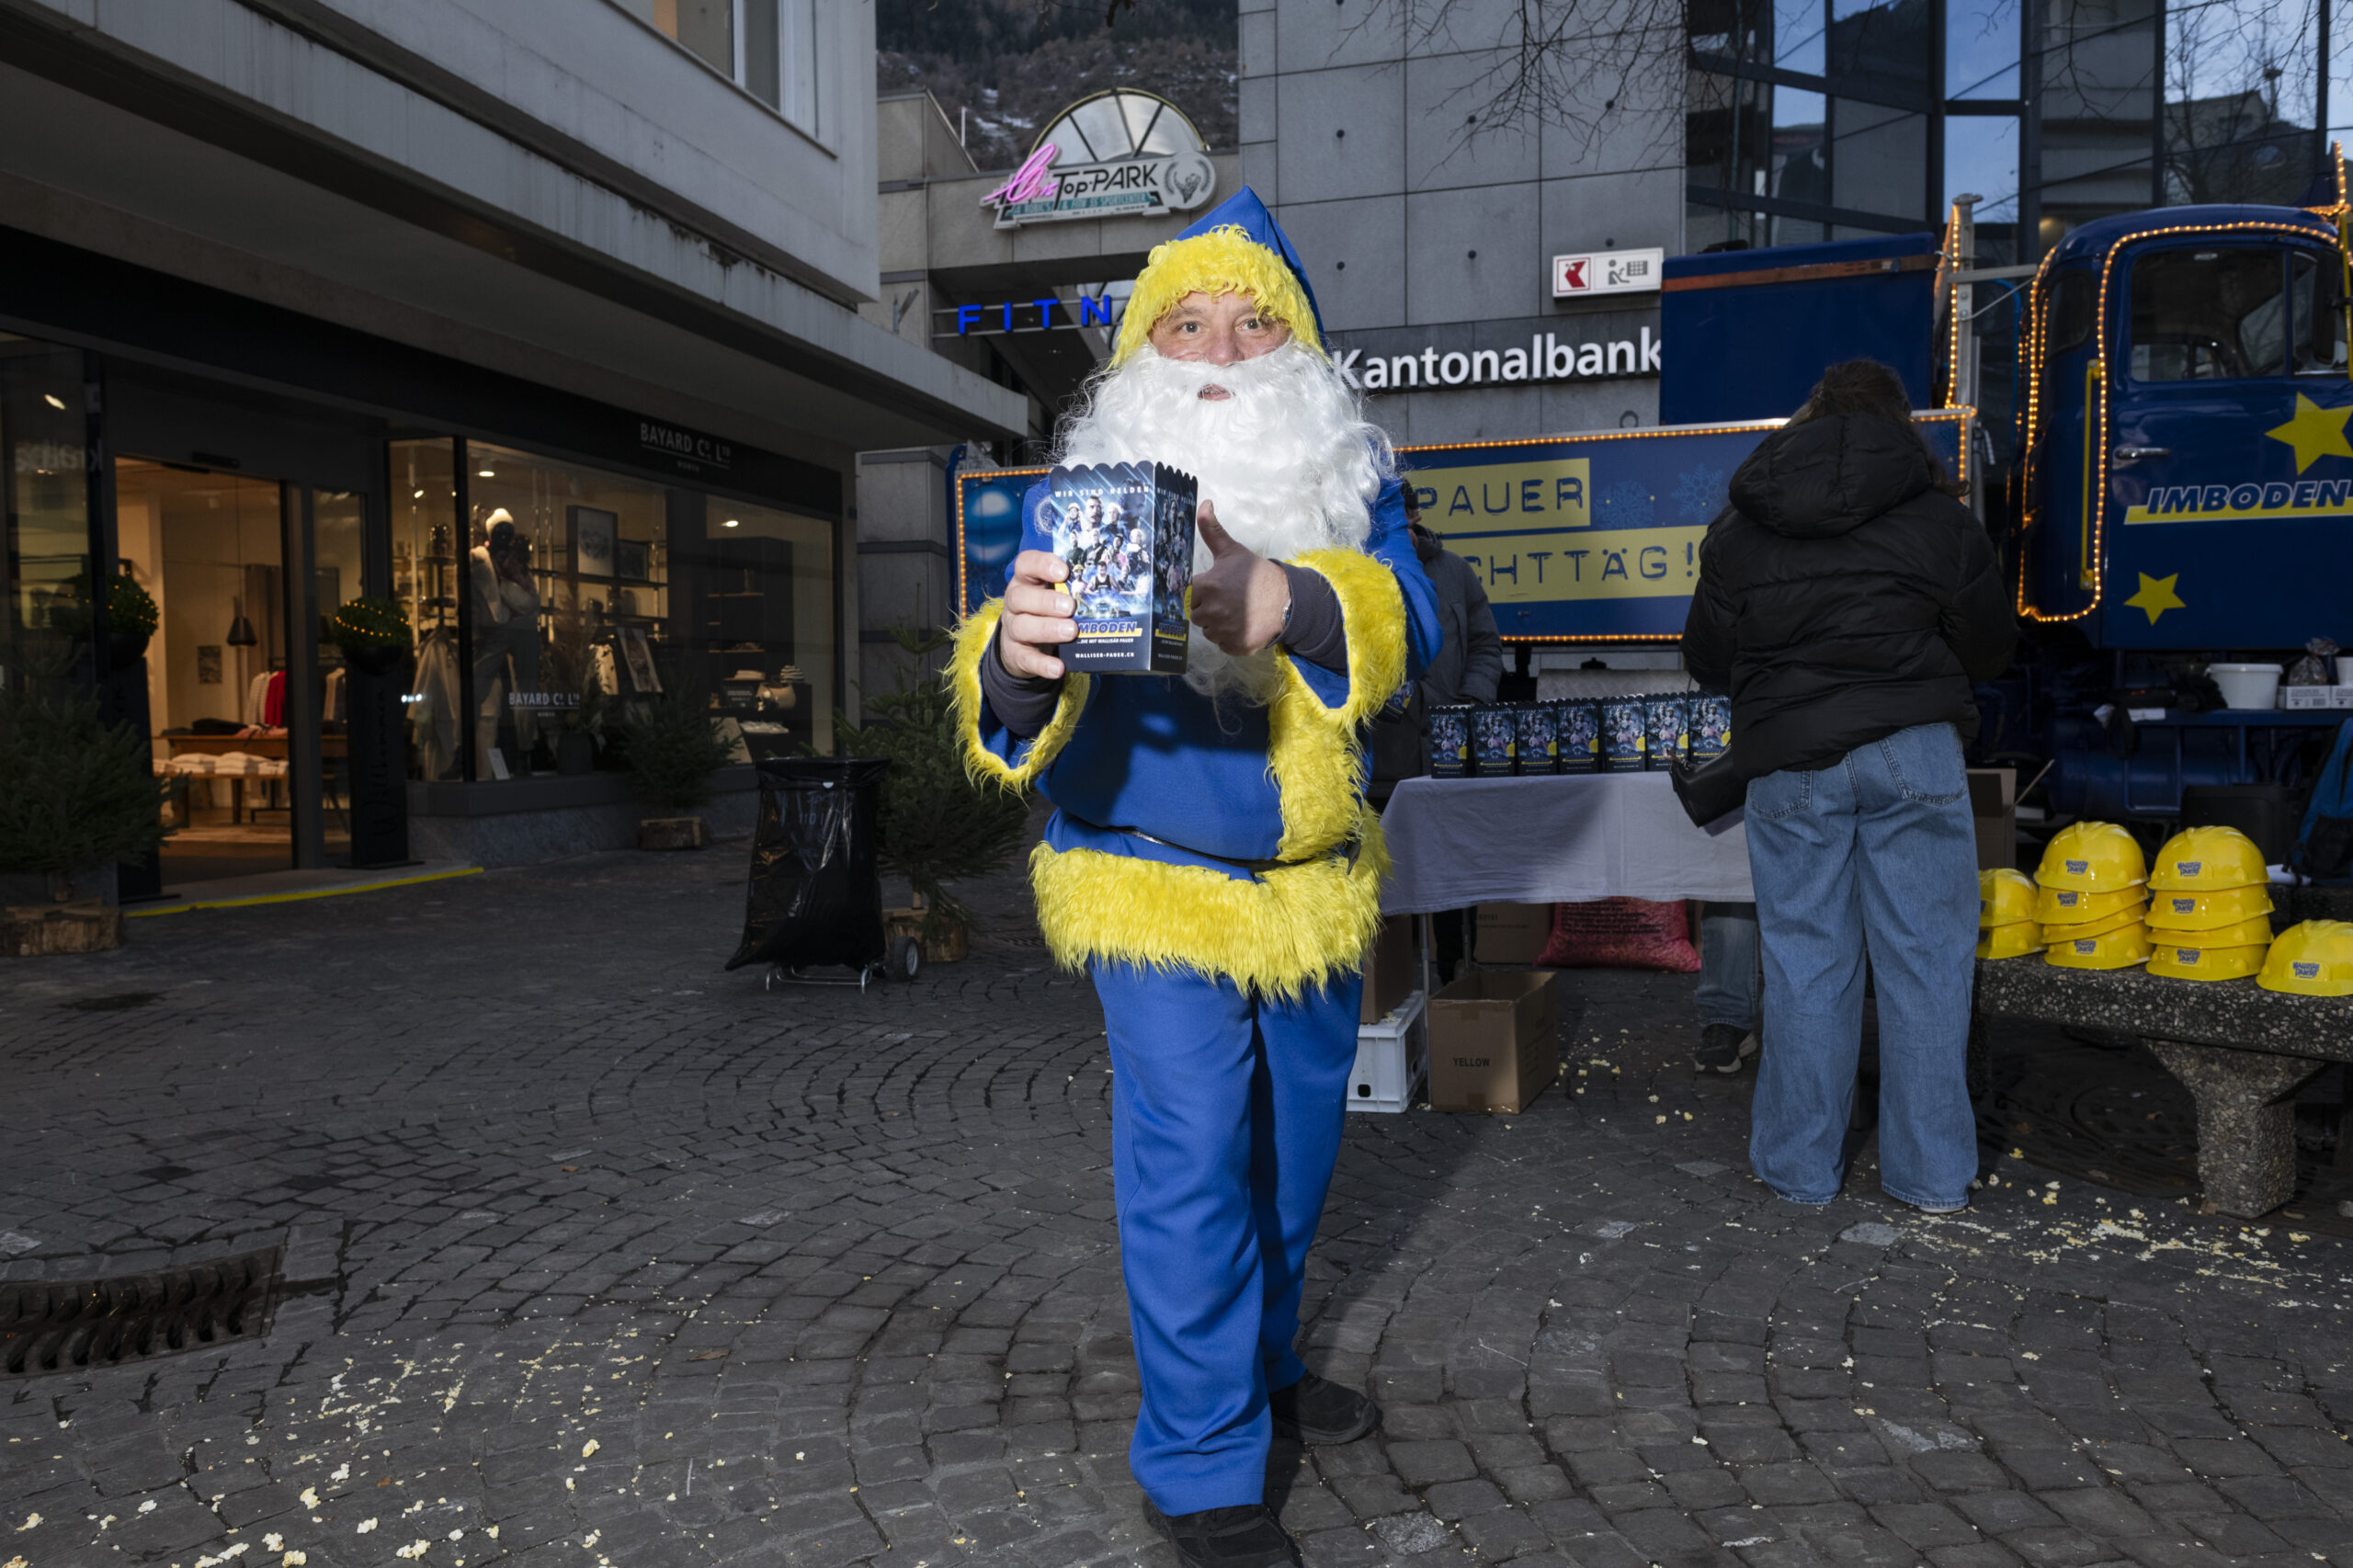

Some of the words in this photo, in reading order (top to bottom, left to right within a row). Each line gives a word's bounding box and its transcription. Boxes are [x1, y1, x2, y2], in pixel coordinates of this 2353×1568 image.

[957, 294, 1110, 335] FITN
[1332, 326, 1661, 390] Kantonalbank
[640, 422, 692, 452] BAYARD
[1109, 485, 1150, 494] HELDEN
[2146, 479, 2353, 515] IMBODEN
[1078, 620, 1138, 633] MBODEN
[1074, 651, 1135, 659] WALLISER-PAUER.CH
[508, 692, 550, 706] BAYARD
[1452, 1057, 1490, 1067] YELLOW
